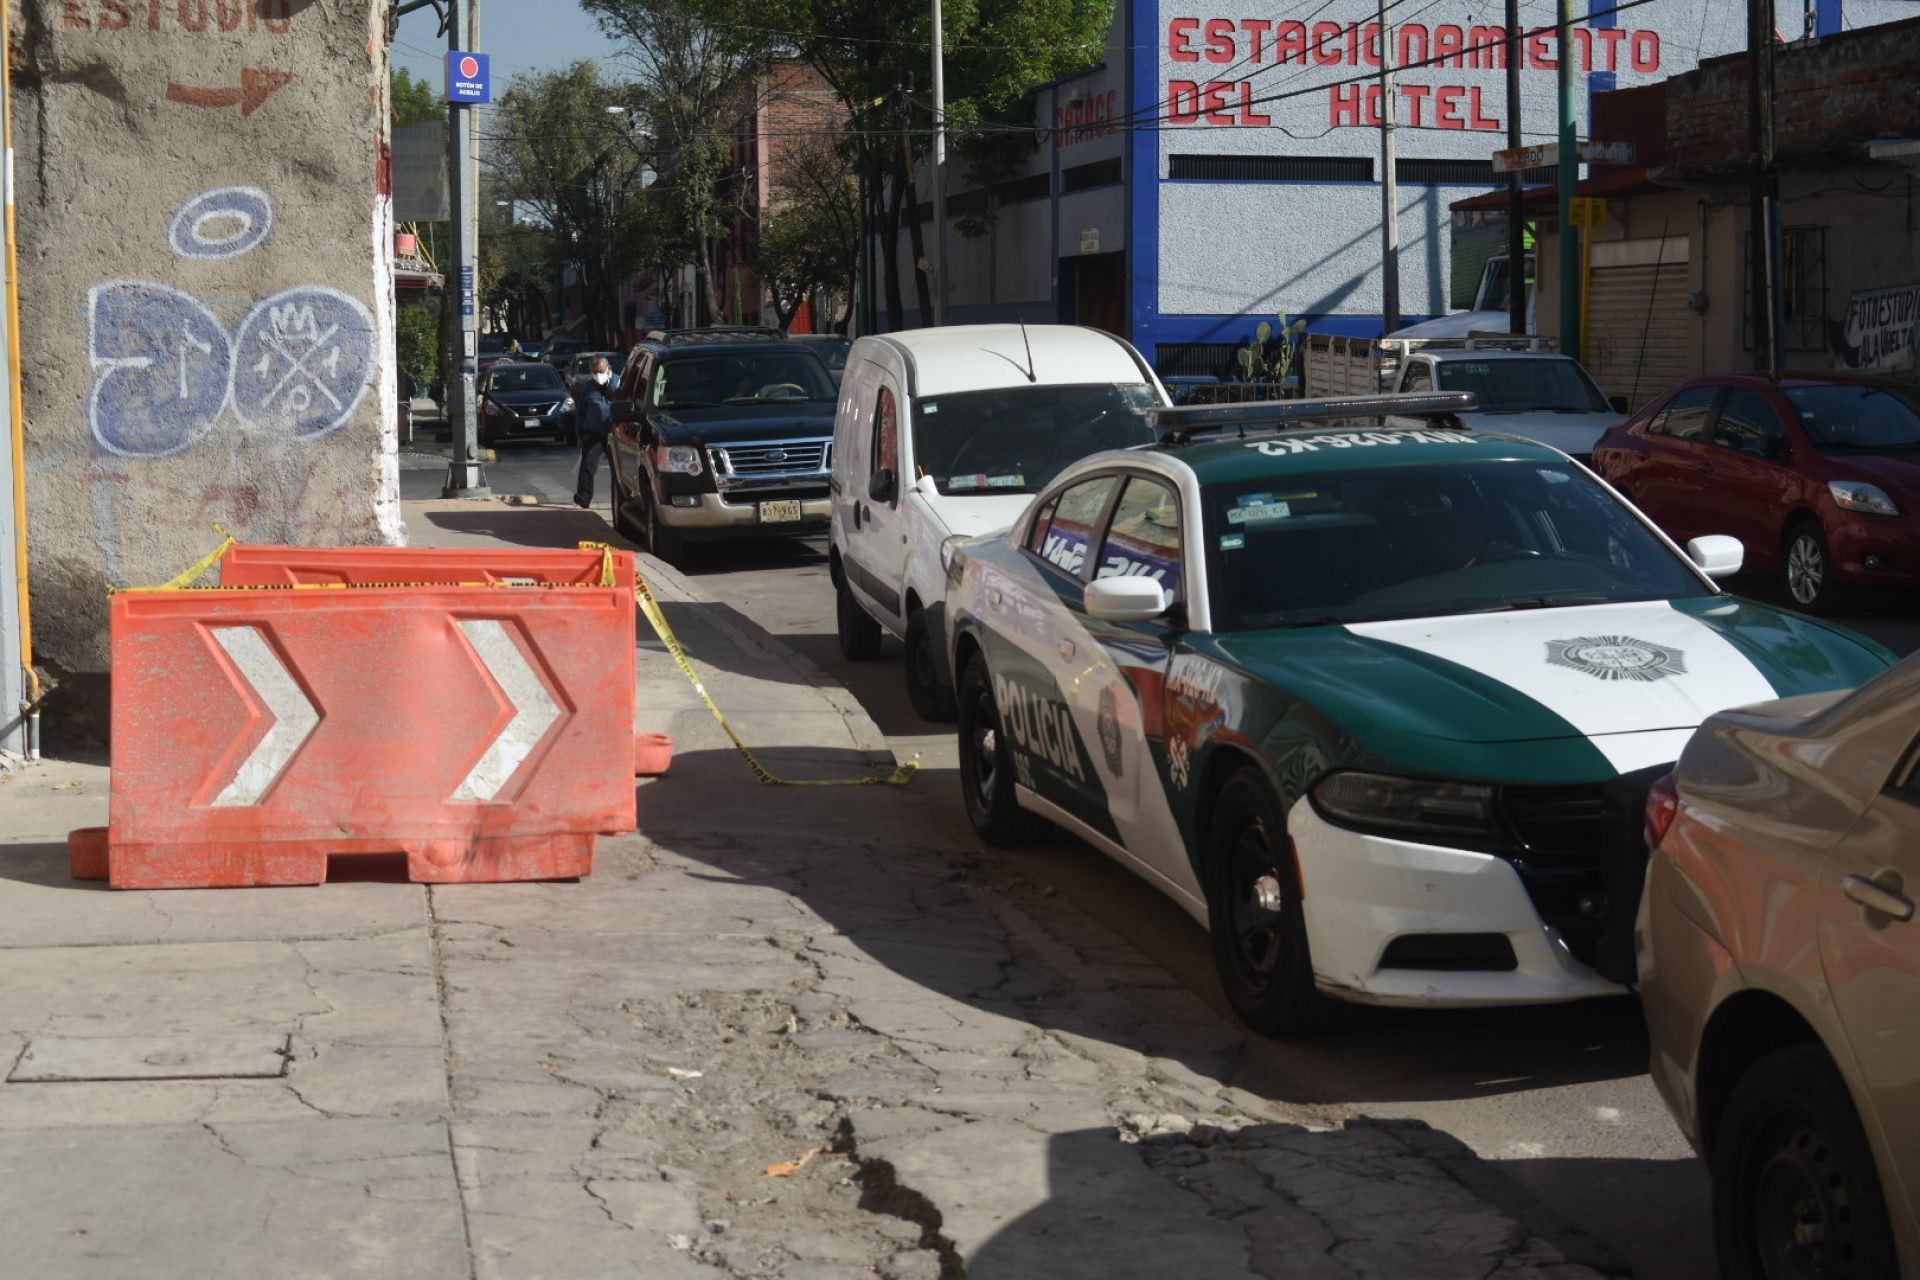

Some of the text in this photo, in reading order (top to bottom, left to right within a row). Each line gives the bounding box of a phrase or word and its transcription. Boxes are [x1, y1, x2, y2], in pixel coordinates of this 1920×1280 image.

[1168, 17, 1660, 73] ESTACIONAMIENTO
[1168, 80, 1500, 130] DEL HOTEL
[995, 672, 1086, 782] POLICIA
